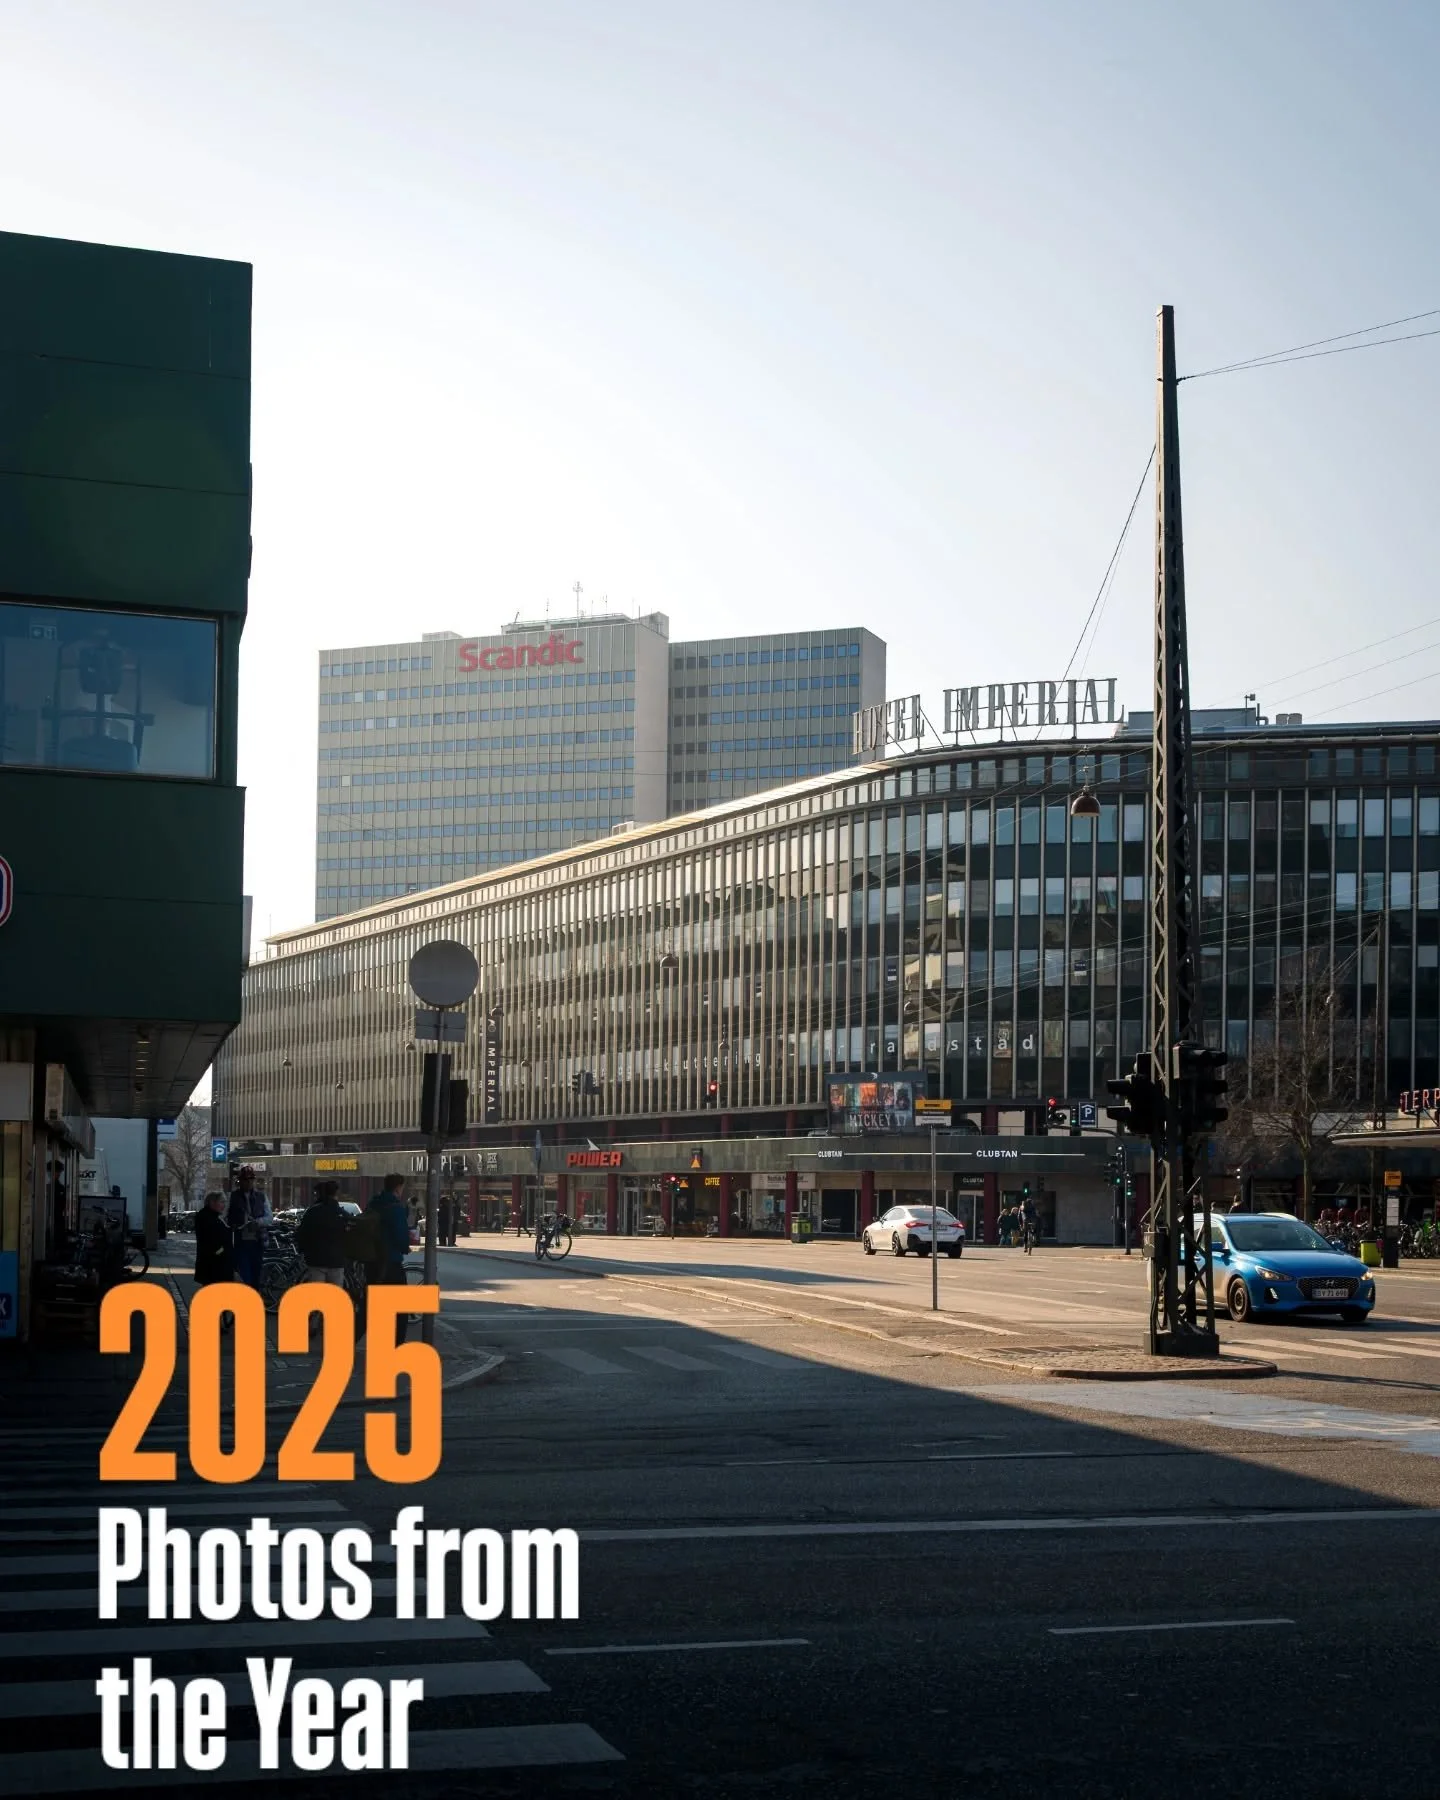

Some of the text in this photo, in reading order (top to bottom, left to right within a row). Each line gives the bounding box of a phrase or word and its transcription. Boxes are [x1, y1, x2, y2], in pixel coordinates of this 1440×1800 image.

[458, 632, 584, 672] Scandic
[853, 678, 1124, 755] HOTEL IMPERIAL
[488, 1040, 496, 1112] IMPERIAL
[1084, 1107, 1093, 1118] P
[849, 1113, 891, 1127] MICKEY
[895, 1113, 907, 1127] 17
[215, 1147, 225, 1158] P
[817, 1150, 843, 1158] CLUBTAN
[976, 1149, 1018, 1158] CLUBTAN
[566, 1150, 623, 1168] POWER
[704, 1177, 720, 1186] COFFEE
